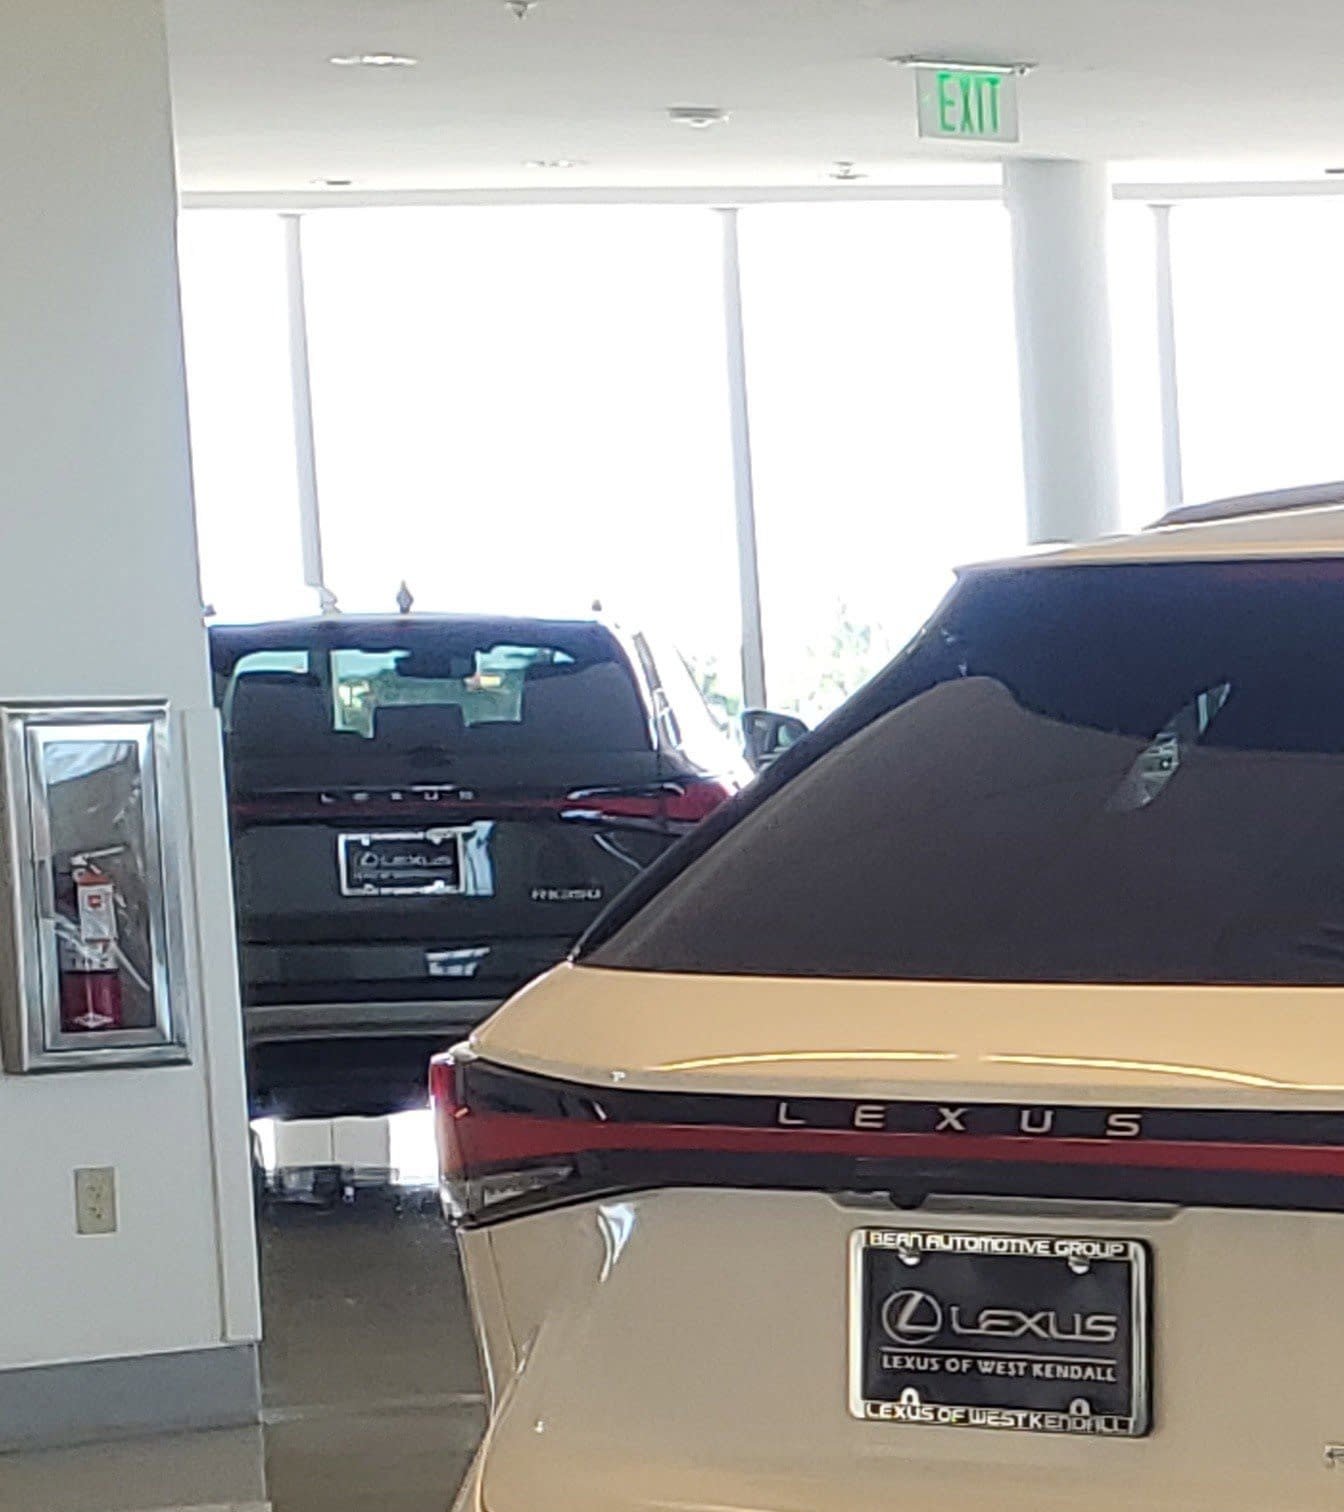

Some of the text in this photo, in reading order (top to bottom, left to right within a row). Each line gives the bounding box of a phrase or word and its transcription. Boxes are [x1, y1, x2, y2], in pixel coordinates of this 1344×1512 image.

[937, 71, 1000, 133] EXIT
[776, 1101, 1143, 1137] LEXUS
[925, 1234, 1052, 1255] AUTOMOTIVE
[1054, 1239, 1125, 1257] GROUP
[952, 1305, 1118, 1343] LEXUS
[881, 1354, 1118, 1383] LEXUS OF WEST KENDALL
[866, 1403, 1121, 1434] LEXUS OF WEST KENDALL
